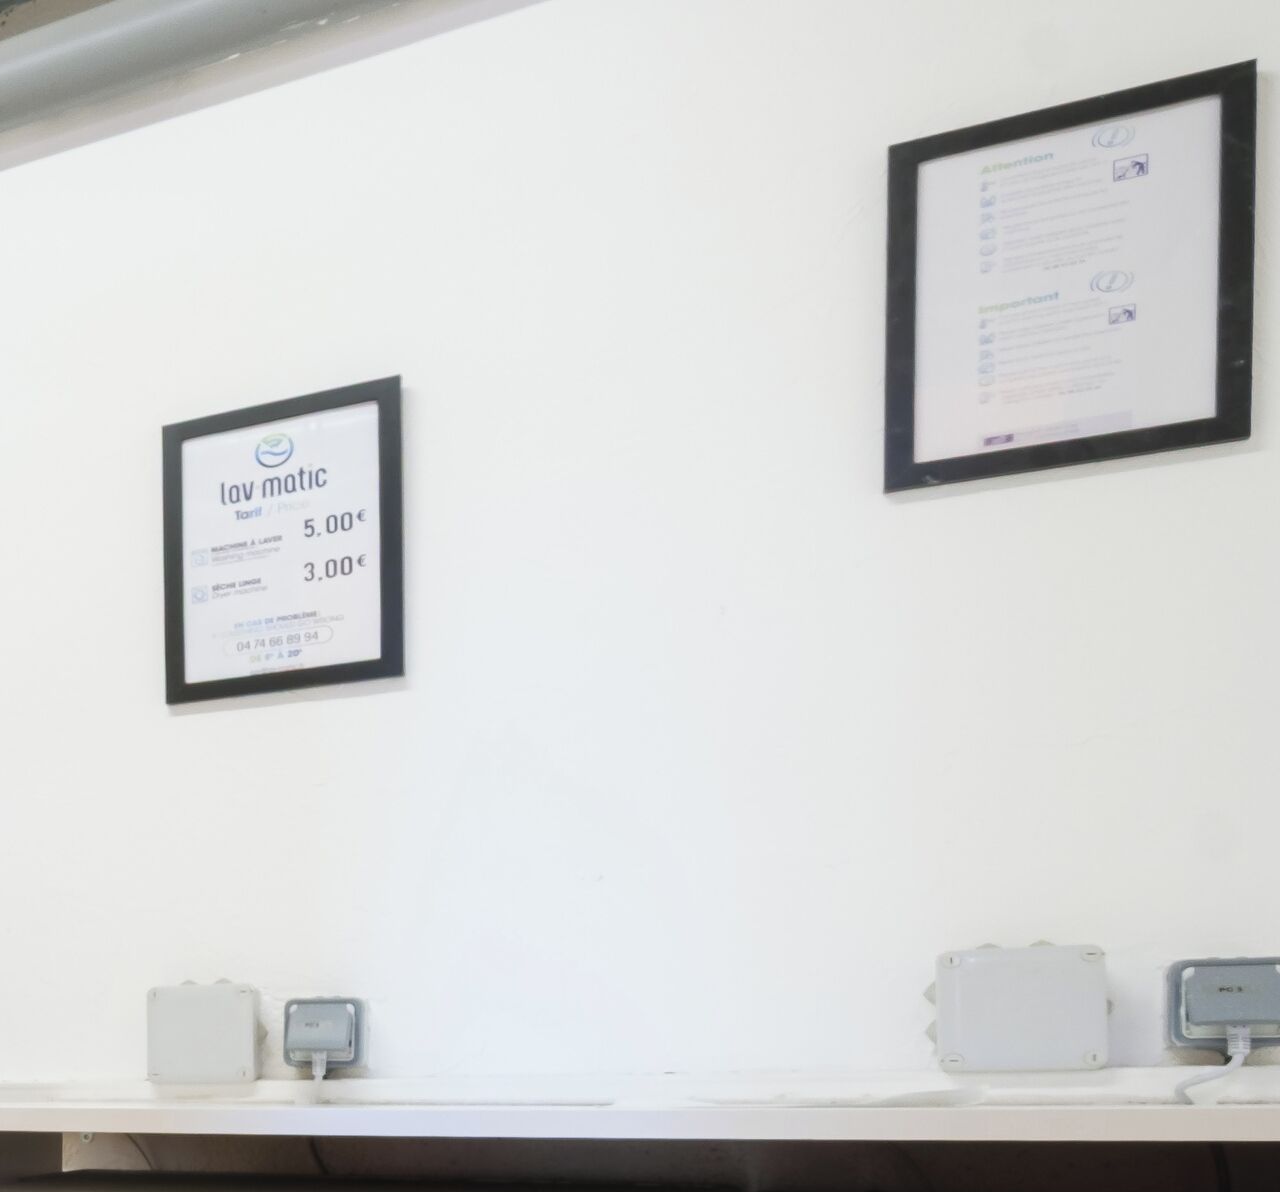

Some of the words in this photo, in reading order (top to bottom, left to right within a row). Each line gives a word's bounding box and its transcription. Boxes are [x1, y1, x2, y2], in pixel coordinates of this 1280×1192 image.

[220, 480, 254, 506] lav
[262, 464, 327, 499] matic
[235, 507, 262, 521] Tarif
